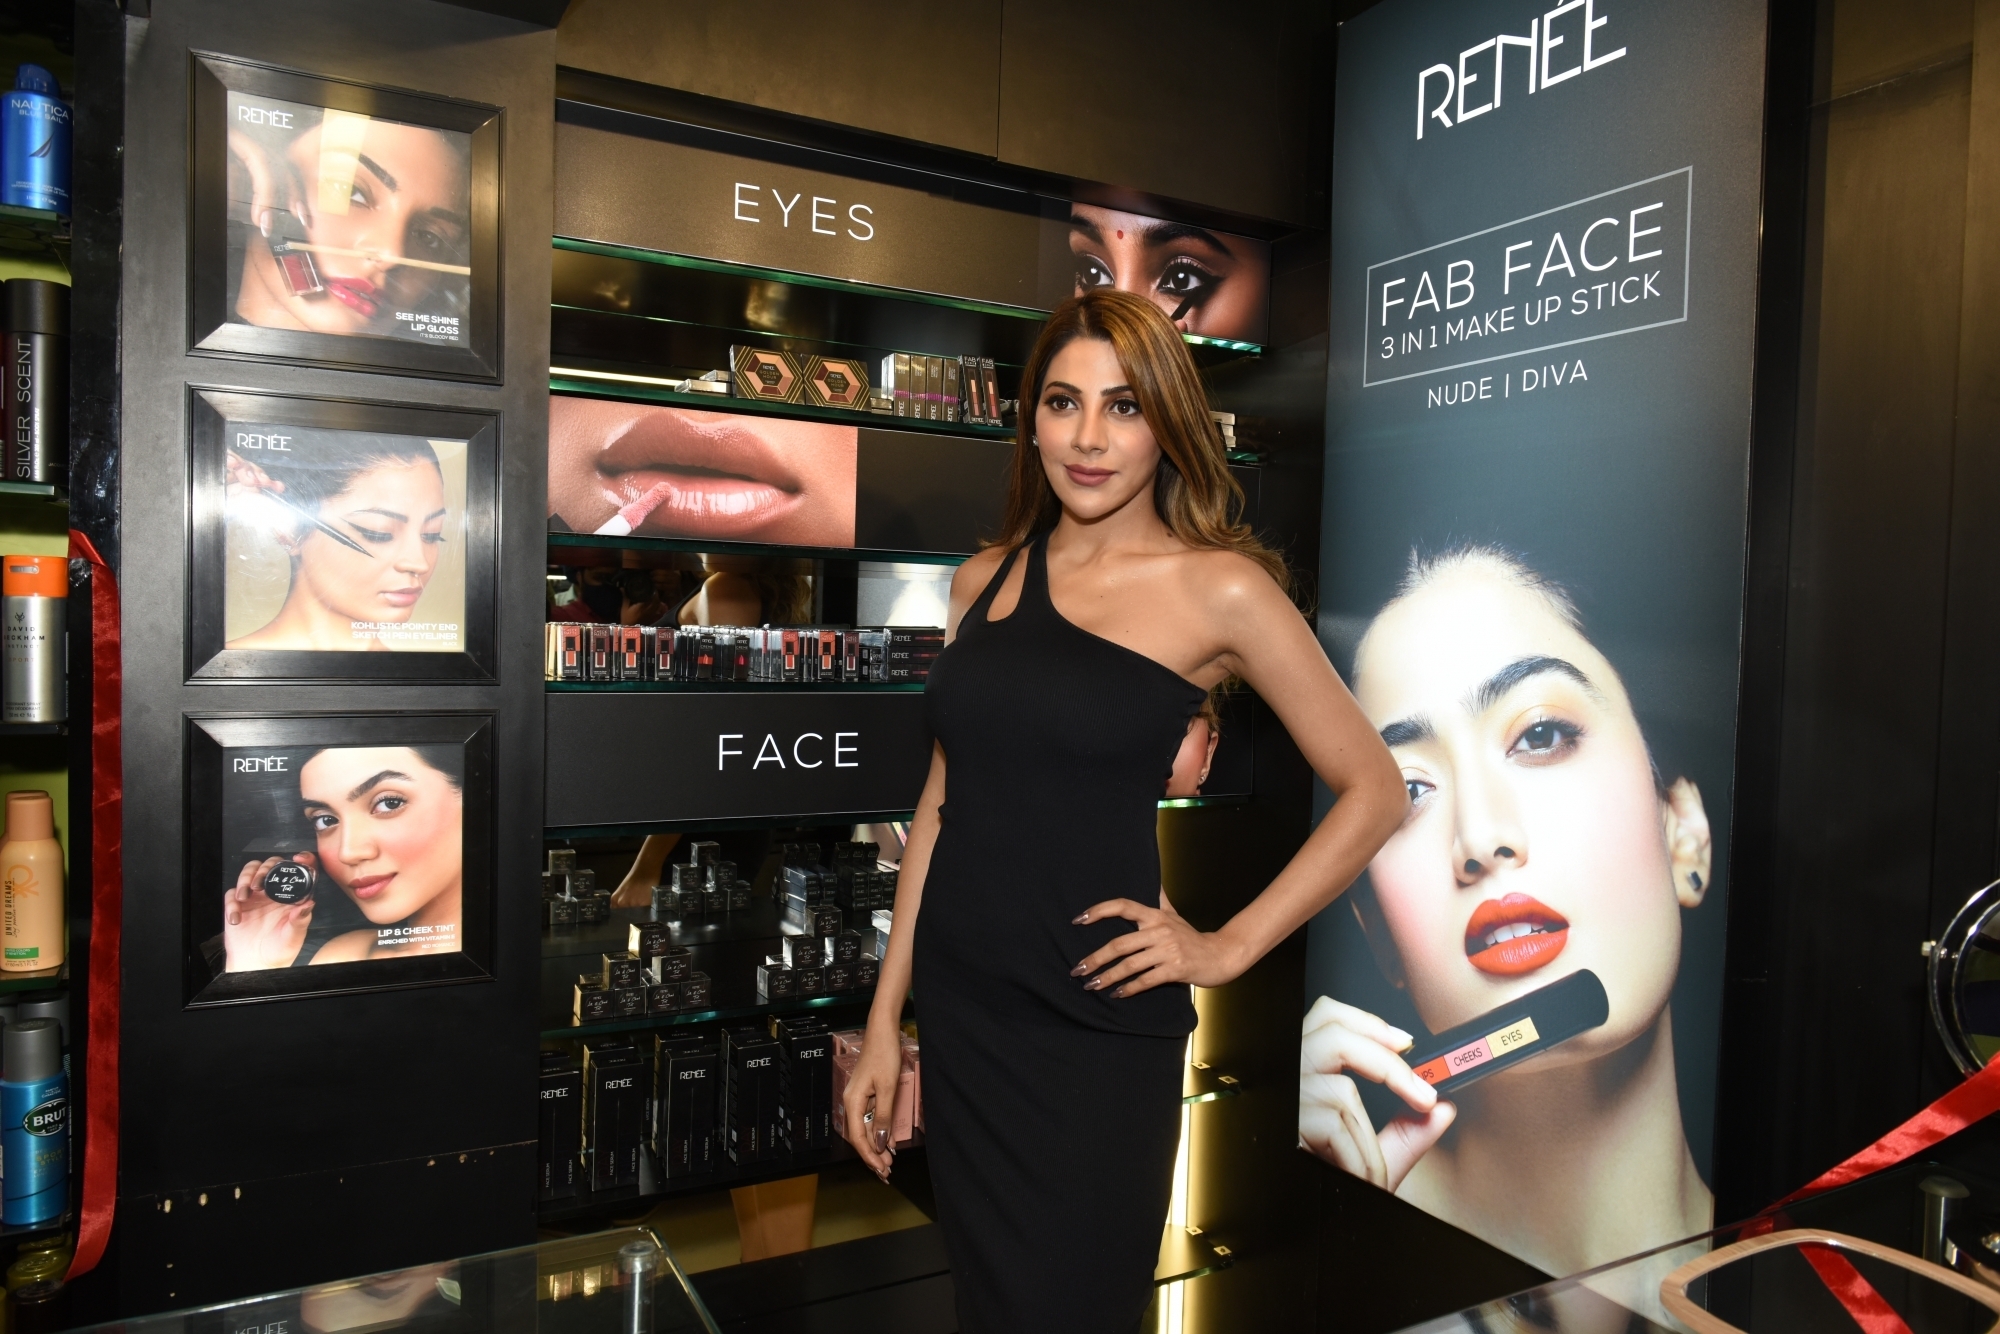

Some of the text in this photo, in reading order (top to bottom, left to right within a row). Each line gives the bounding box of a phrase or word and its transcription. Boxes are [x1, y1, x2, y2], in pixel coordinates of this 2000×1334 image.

[12, 99, 69, 119] NAUTICA
[45, 113, 63, 124] SAIL
[238, 106, 293, 129] RENÉE
[735, 182, 874, 240] EYES
[1382, 202, 1663, 326] FAB FACE
[396, 312, 459, 325] SEE ME SHINE
[1381, 270, 1661, 359] 3 IN 1 MAKE UP STICK
[411, 323, 459, 334] LIP GLOSS
[1428, 376, 1492, 409] NUDE
[1523, 359, 1588, 392] DIVA
[17, 338, 31, 478] SILVER SCENT
[236, 433, 291, 451] RENÉE
[351, 622, 400, 630] KOHLISTIC
[402, 622, 437, 630] POINTY
[352, 631, 390, 639] SKETCH
[413, 632, 458, 640] EYELINER
[719, 732, 858, 770] FACE
[233, 755, 288, 773] RENÉE
[4, 880, 12, 908] DREAMS
[378, 929, 392, 937] LIP
[403, 926, 433, 935] CHEEK
[435, 924, 455, 932] TINT
[1501, 1029, 1523, 1046] EYES
[1454, 1047, 1482, 1067] CHEEKS
[1418, 1068, 1434, 1080] IPS
[33, 1107, 66, 1126] BRUT
